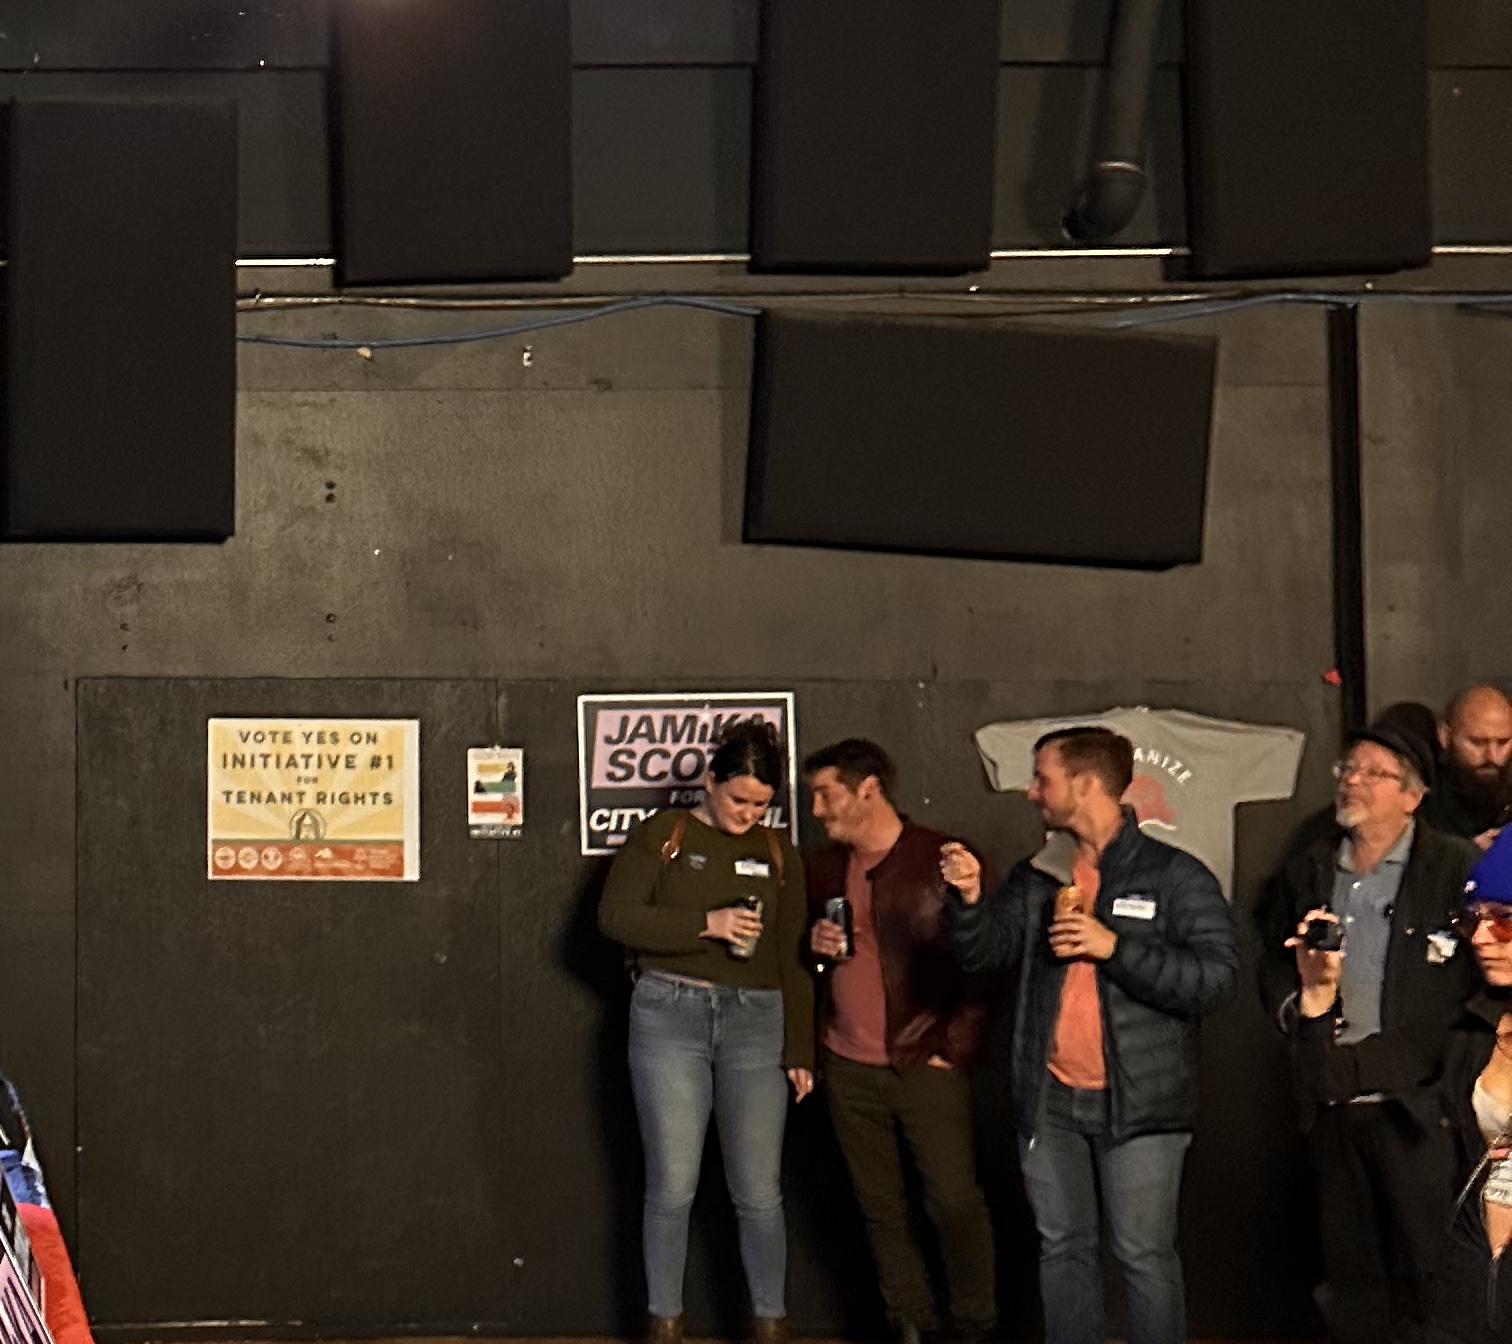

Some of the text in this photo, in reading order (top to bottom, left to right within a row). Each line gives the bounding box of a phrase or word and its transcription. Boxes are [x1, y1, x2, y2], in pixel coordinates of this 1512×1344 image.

[239, 730, 378, 745] VOTE YES ON
[222, 753, 394, 769] INITIATIVE #1
[606, 748, 718, 782] SCO
[1134, 747, 1192, 786] ANIZE
[297, 776, 318, 784] FOR
[223, 791, 393, 805] TENANT RIGHTS
